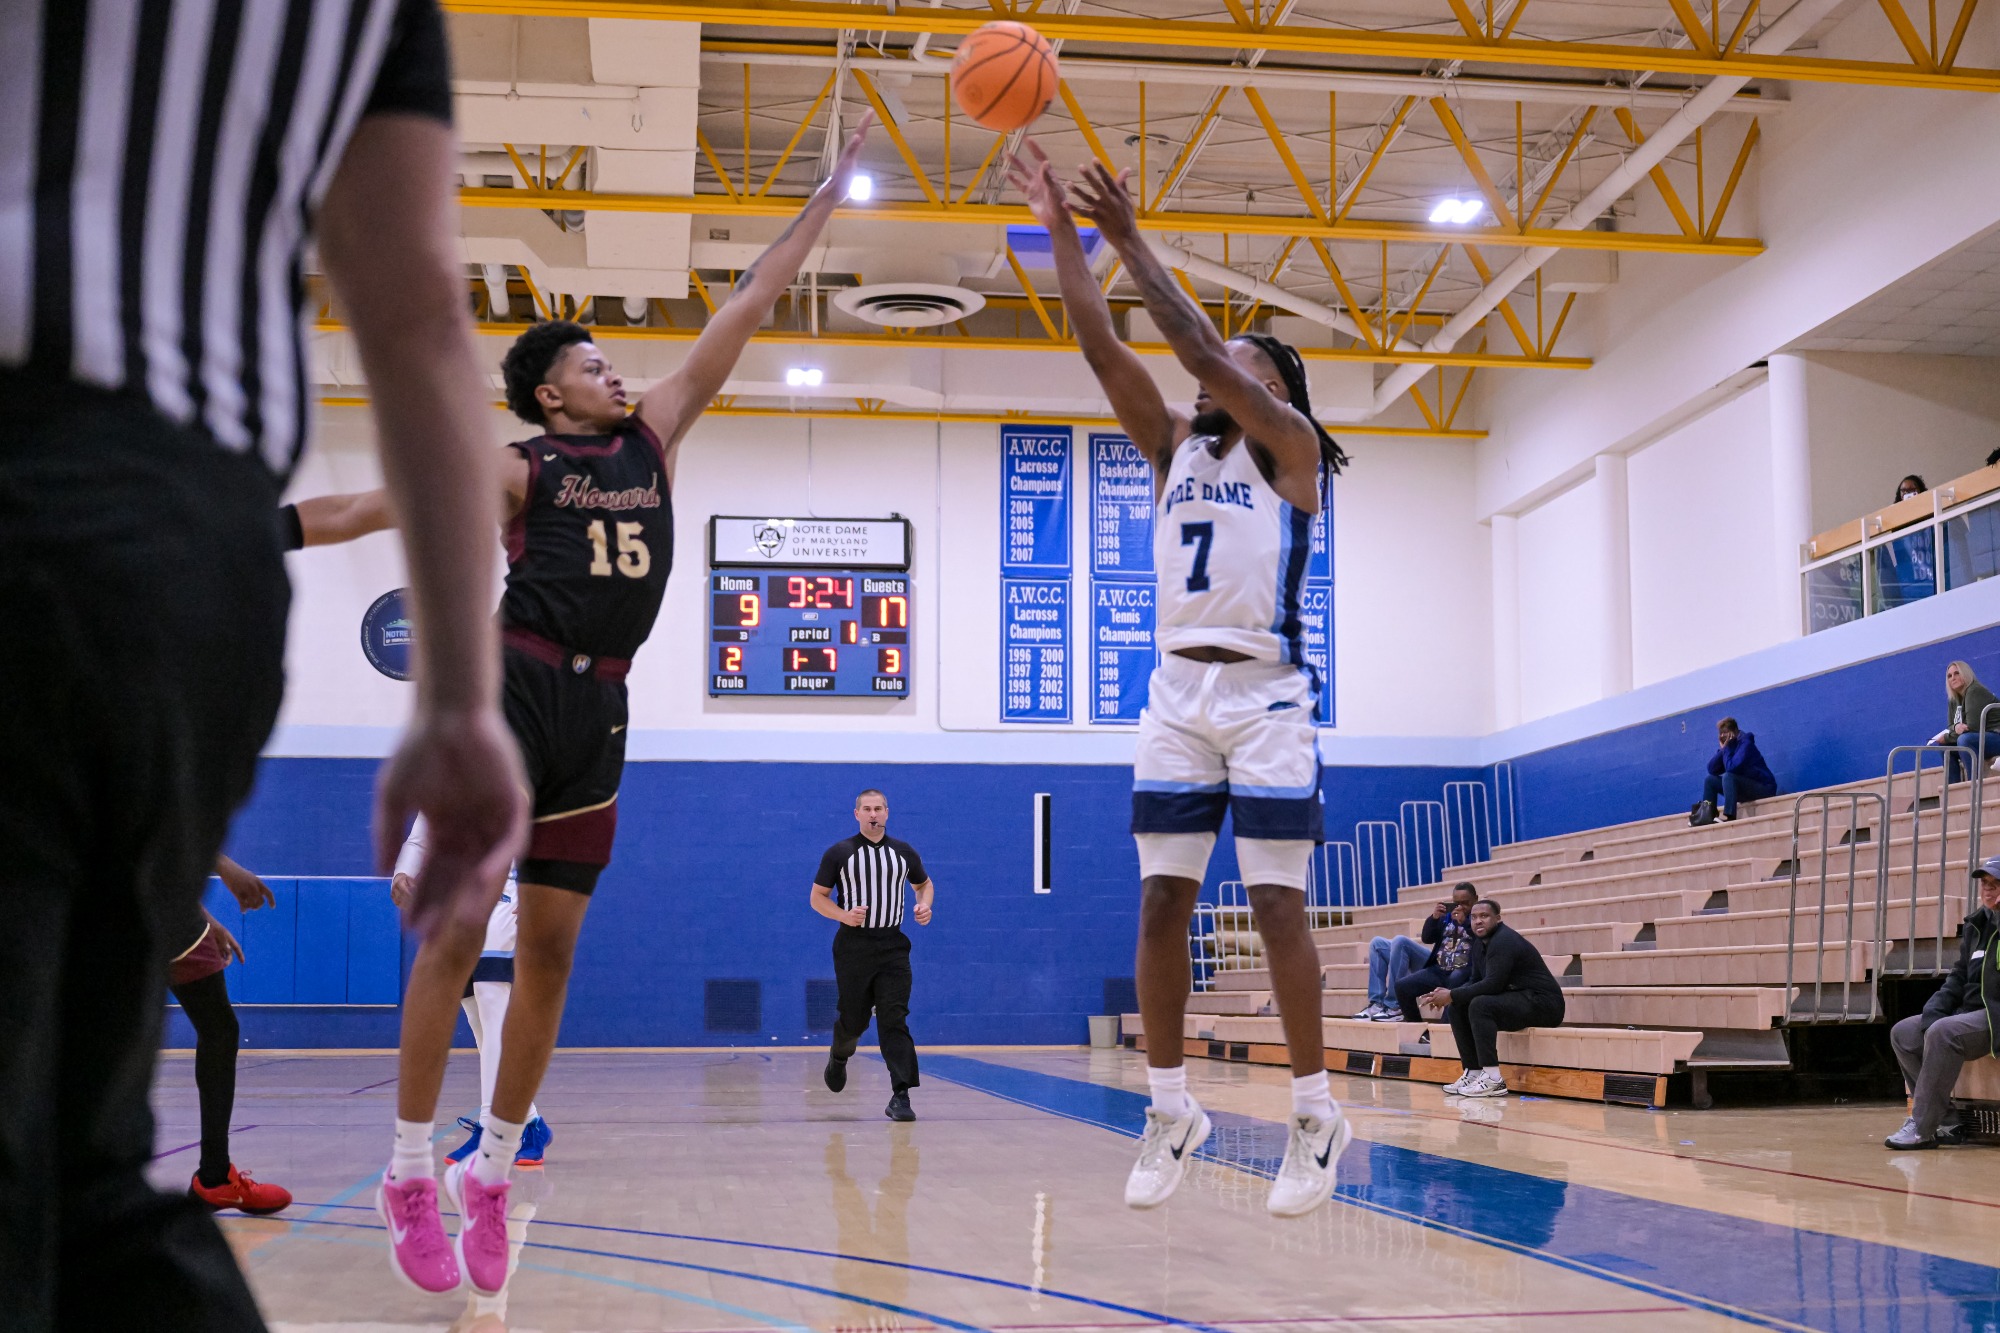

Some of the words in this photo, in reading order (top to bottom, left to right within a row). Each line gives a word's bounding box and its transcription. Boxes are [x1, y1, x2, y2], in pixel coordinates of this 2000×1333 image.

[1009, 439, 1064, 456] A.W.C.C.
[1015, 458, 1058, 473] Lacrosse
[1100, 463, 1150, 478] Basketball
[1010, 476, 1062, 493] Champions
[1099, 481, 1150, 498] Champions
[1202, 482, 1254, 510] DAME
[1010, 501, 1034, 514] 2004
[1098, 505, 1120, 518] 1996
[1129, 505, 1151, 519] 2007
[792, 525, 830, 534] NOTRE
[835, 526, 868, 535] DAME
[1010, 516, 1034, 530] 2005
[1098, 521, 1120, 534] 1997
[810, 537, 868, 545] MARYLAND
[1010, 532, 1034, 546] 2006
[1098, 536, 1120, 549] 1998
[586, 519, 651, 579] 15
[792, 548, 867, 557] UNIVERSITY
[1010, 548, 1034, 561] 2007
[1181, 521, 1214, 592] 7
[1098, 551, 1120, 565] 1999
[720, 576, 754, 591] Home
[863, 578, 905, 593] Guests
[788, 576, 853, 608] 9:24
[1008, 586, 1064, 604] A.W.C.C.
[1098, 589, 1153, 607] A.W.C.C.
[740, 594, 759, 626] 9
[880, 596, 907, 627] 17
[1014, 605, 1058, 621] Lacrosse
[1110, 608, 1141, 624] Tennis
[385, 630, 409, 639] NOTRE
[739, 631, 749, 640] B
[791, 627, 830, 642] period
[849, 621, 857, 643] 1
[872, 632, 881, 642] B
[1010, 624, 1062, 642] Champions
[1100, 626, 1151, 644] Champions
[726, 647, 741, 671] 2
[885, 649, 900, 673] 3
[1008, 649, 1031, 662] 1996
[1040, 649, 1064, 663] 2000
[1099, 651, 1119, 665] 1998
[1008, 664, 1031, 678] 1997
[1040, 664, 1063, 678] 2001
[1099, 667, 1119, 681] 1999
[716, 675, 744, 688] fouls
[790, 675, 829, 690] player
[875, 677, 903, 690] fouls
[1008, 680, 1031, 693] 1998
[1039, 680, 1063, 694] 2002
[1099, 684, 1120, 698] 2006
[1008, 695, 1031, 709] 1999
[1039, 695, 1063, 710] 2003
[1099, 700, 1119, 715] 2007
